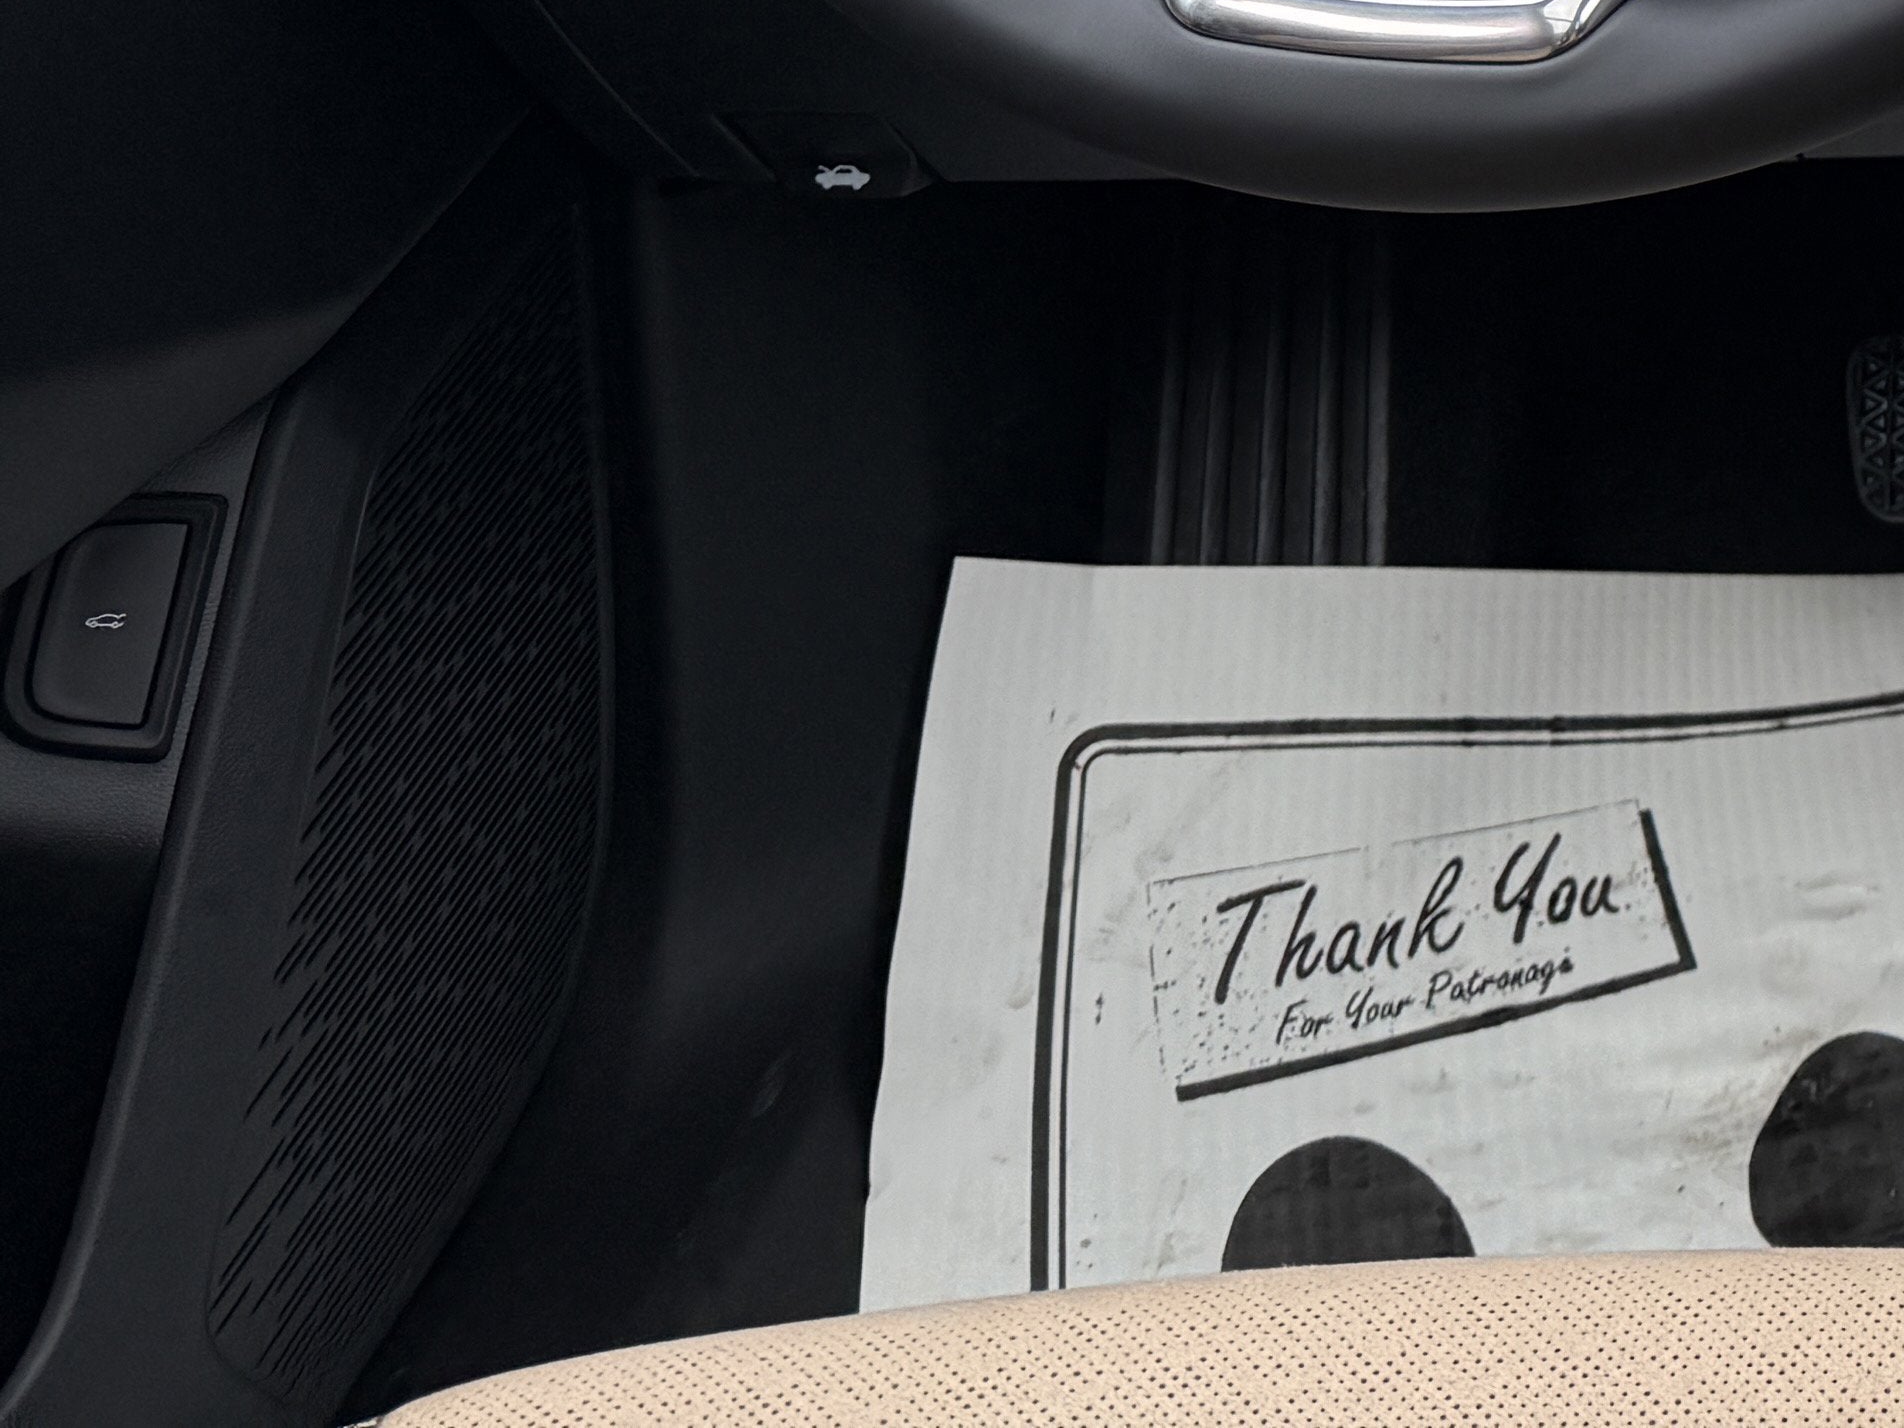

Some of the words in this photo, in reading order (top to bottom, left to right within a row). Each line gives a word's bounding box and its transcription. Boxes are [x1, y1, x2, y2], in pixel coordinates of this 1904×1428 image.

[1216, 855, 1468, 1005] Thank
[1491, 831, 1621, 945] You
[1275, 1002, 1332, 1044] For
[1344, 989, 1414, 1030] Your
